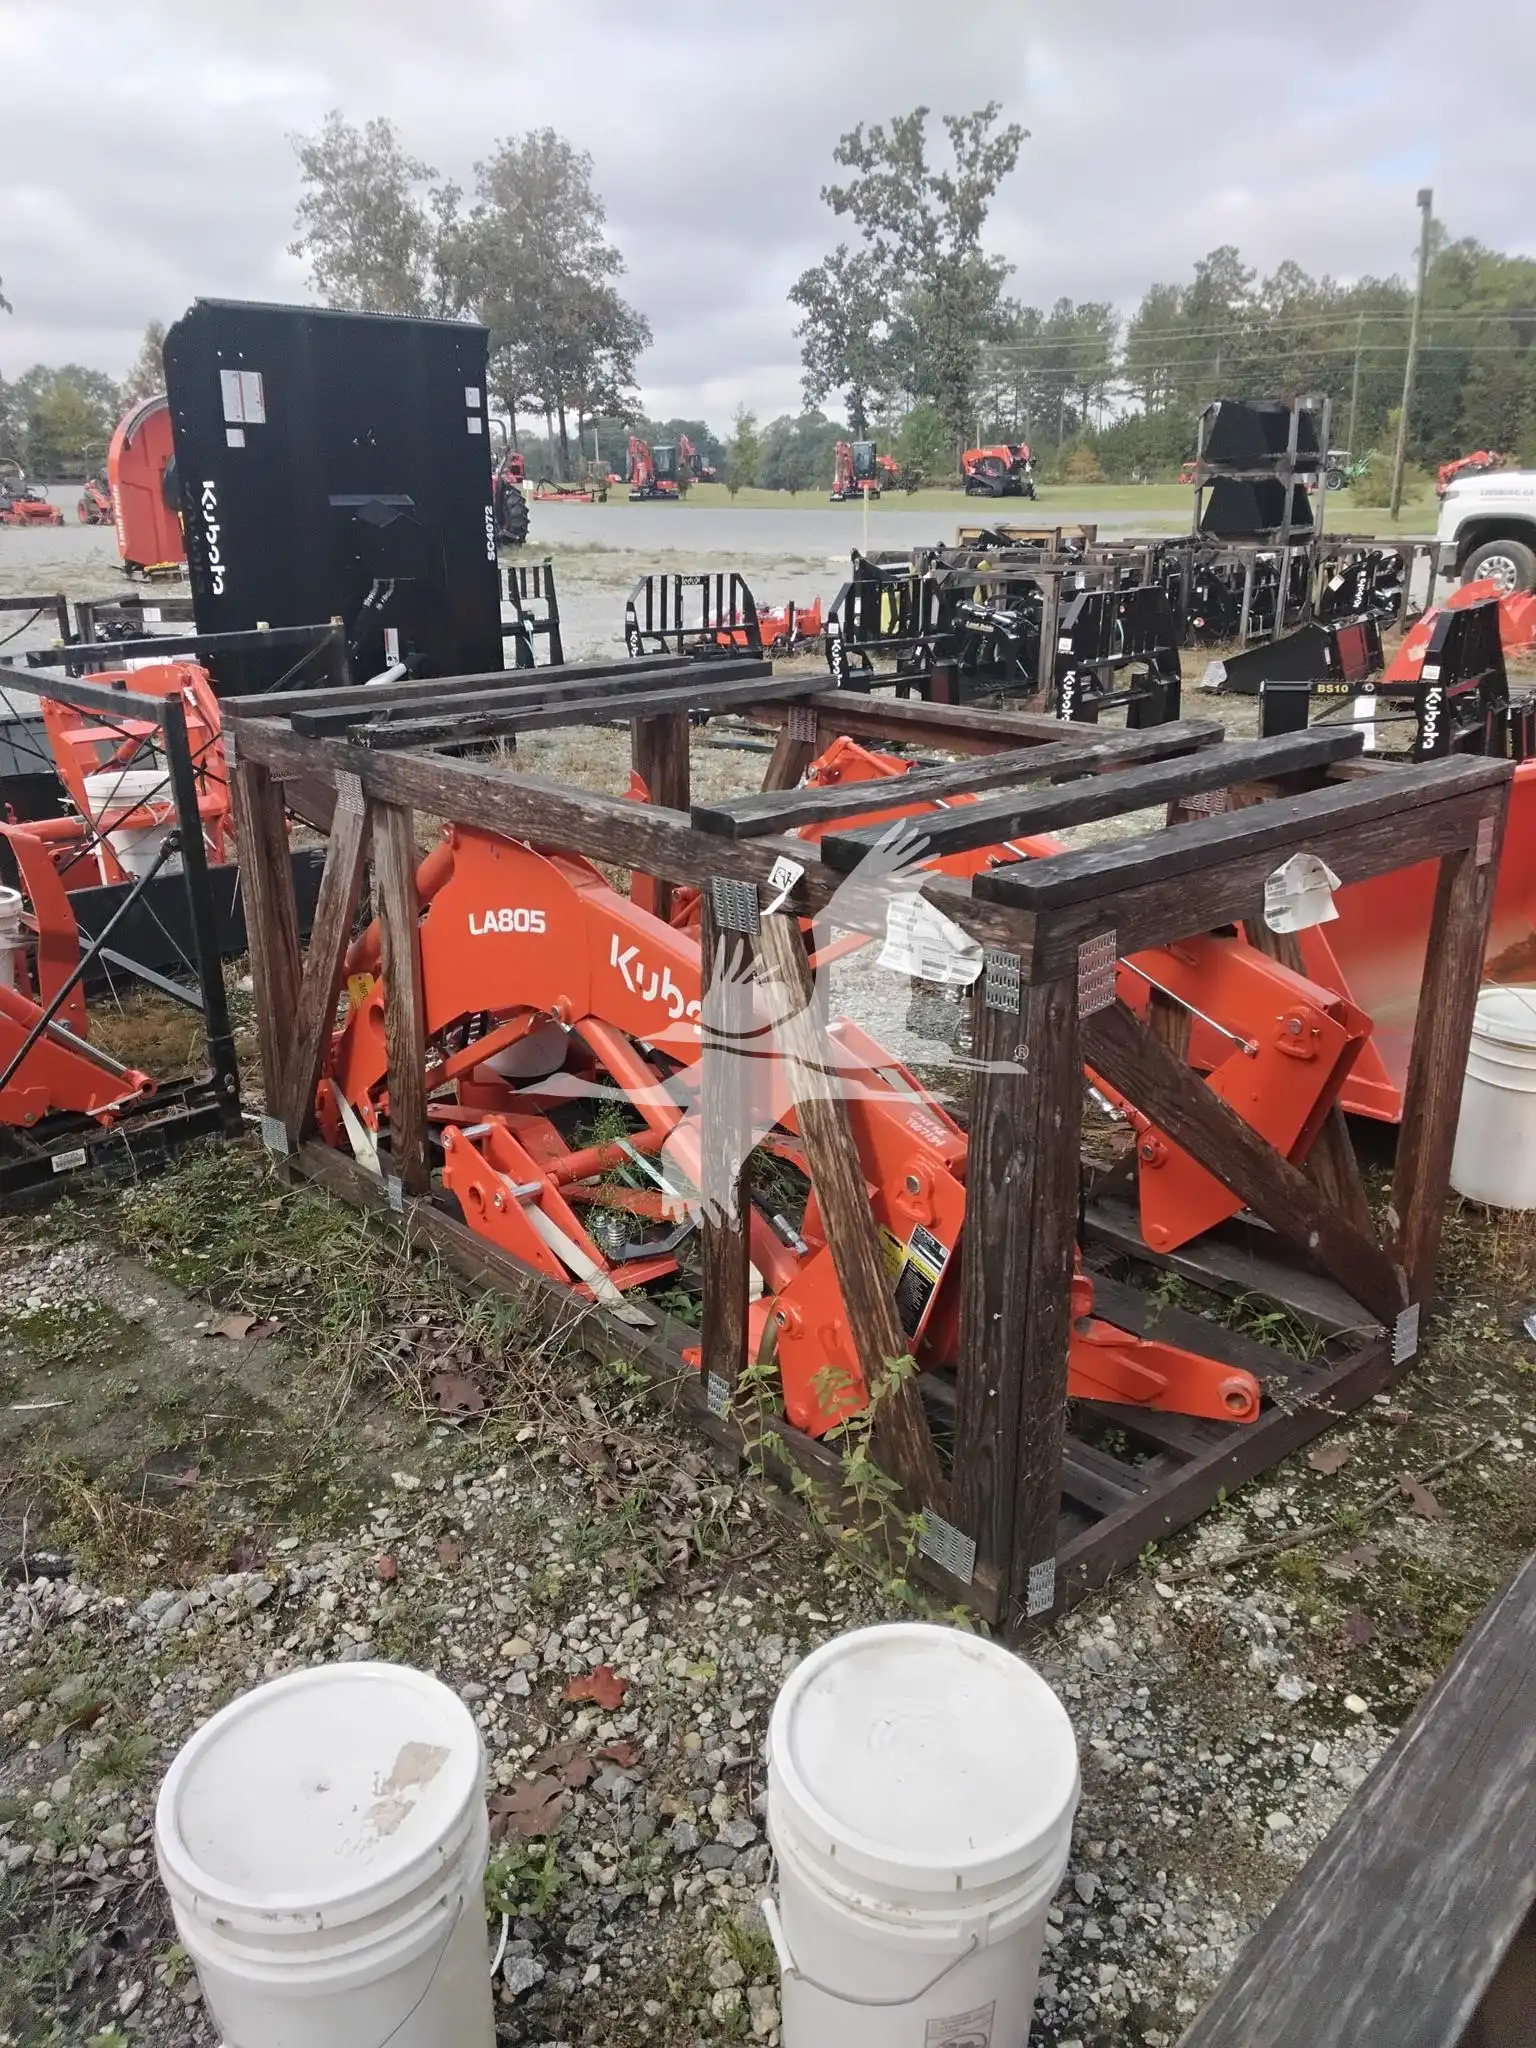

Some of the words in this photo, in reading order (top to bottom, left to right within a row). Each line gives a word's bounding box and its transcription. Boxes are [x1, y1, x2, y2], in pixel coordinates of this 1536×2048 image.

[201, 481, 225, 595] Kubota
[484, 505, 496, 561] SC4072
[1317, 684, 1349, 693] BS10
[1422, 687, 1443, 749] Kubota
[468, 908, 546, 936] LA805
